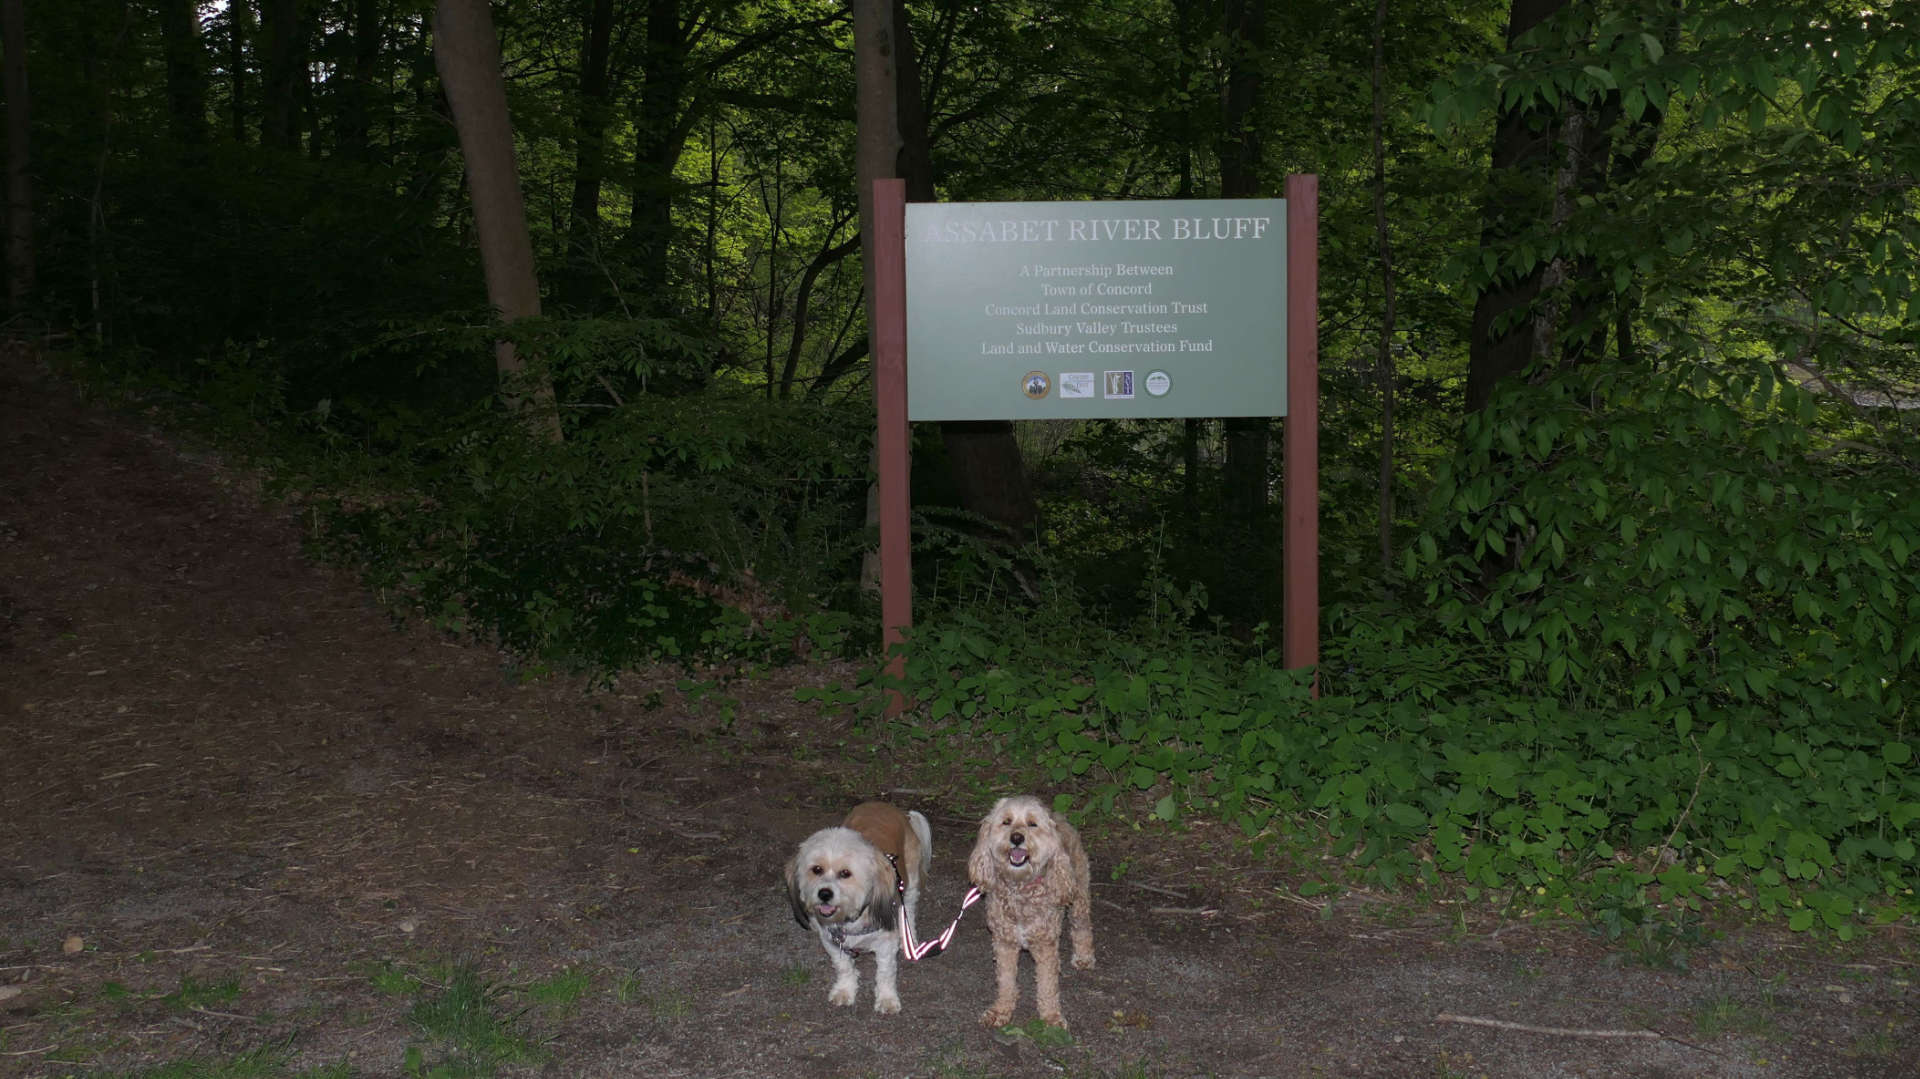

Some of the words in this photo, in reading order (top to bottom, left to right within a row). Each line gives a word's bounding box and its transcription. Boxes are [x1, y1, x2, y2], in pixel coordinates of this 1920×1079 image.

[924, 219, 1058, 242] ASSABET
[1068, 218, 1163, 241] RIVER
[1172, 216, 1271, 240] BLUFF
[1019, 265, 1030, 277] A
[1034, 264, 1113, 279] Partnership
[1116, 263, 1174, 276] Between
[1041, 283, 1076, 296] Town
[1079, 283, 1094, 296] of
[1096, 282, 1153, 295] Concord
[984, 303, 1041, 316] Concord
[1044, 303, 1077, 315] Land
[1080, 302, 1168, 315] Conservation
[1171, 301, 1208, 314] Trust
[1016, 323, 1073, 337] Sudbury
[1076, 322, 1118, 335] Valley
[1121, 321, 1178, 334] Trustees
[981, 342, 1014, 355] Land
[1017, 342, 1042, 354] and
[1045, 342, 1085, 354] Water
[1088, 341, 1176, 354] Conservation
[1179, 339, 1213, 352] Fund
